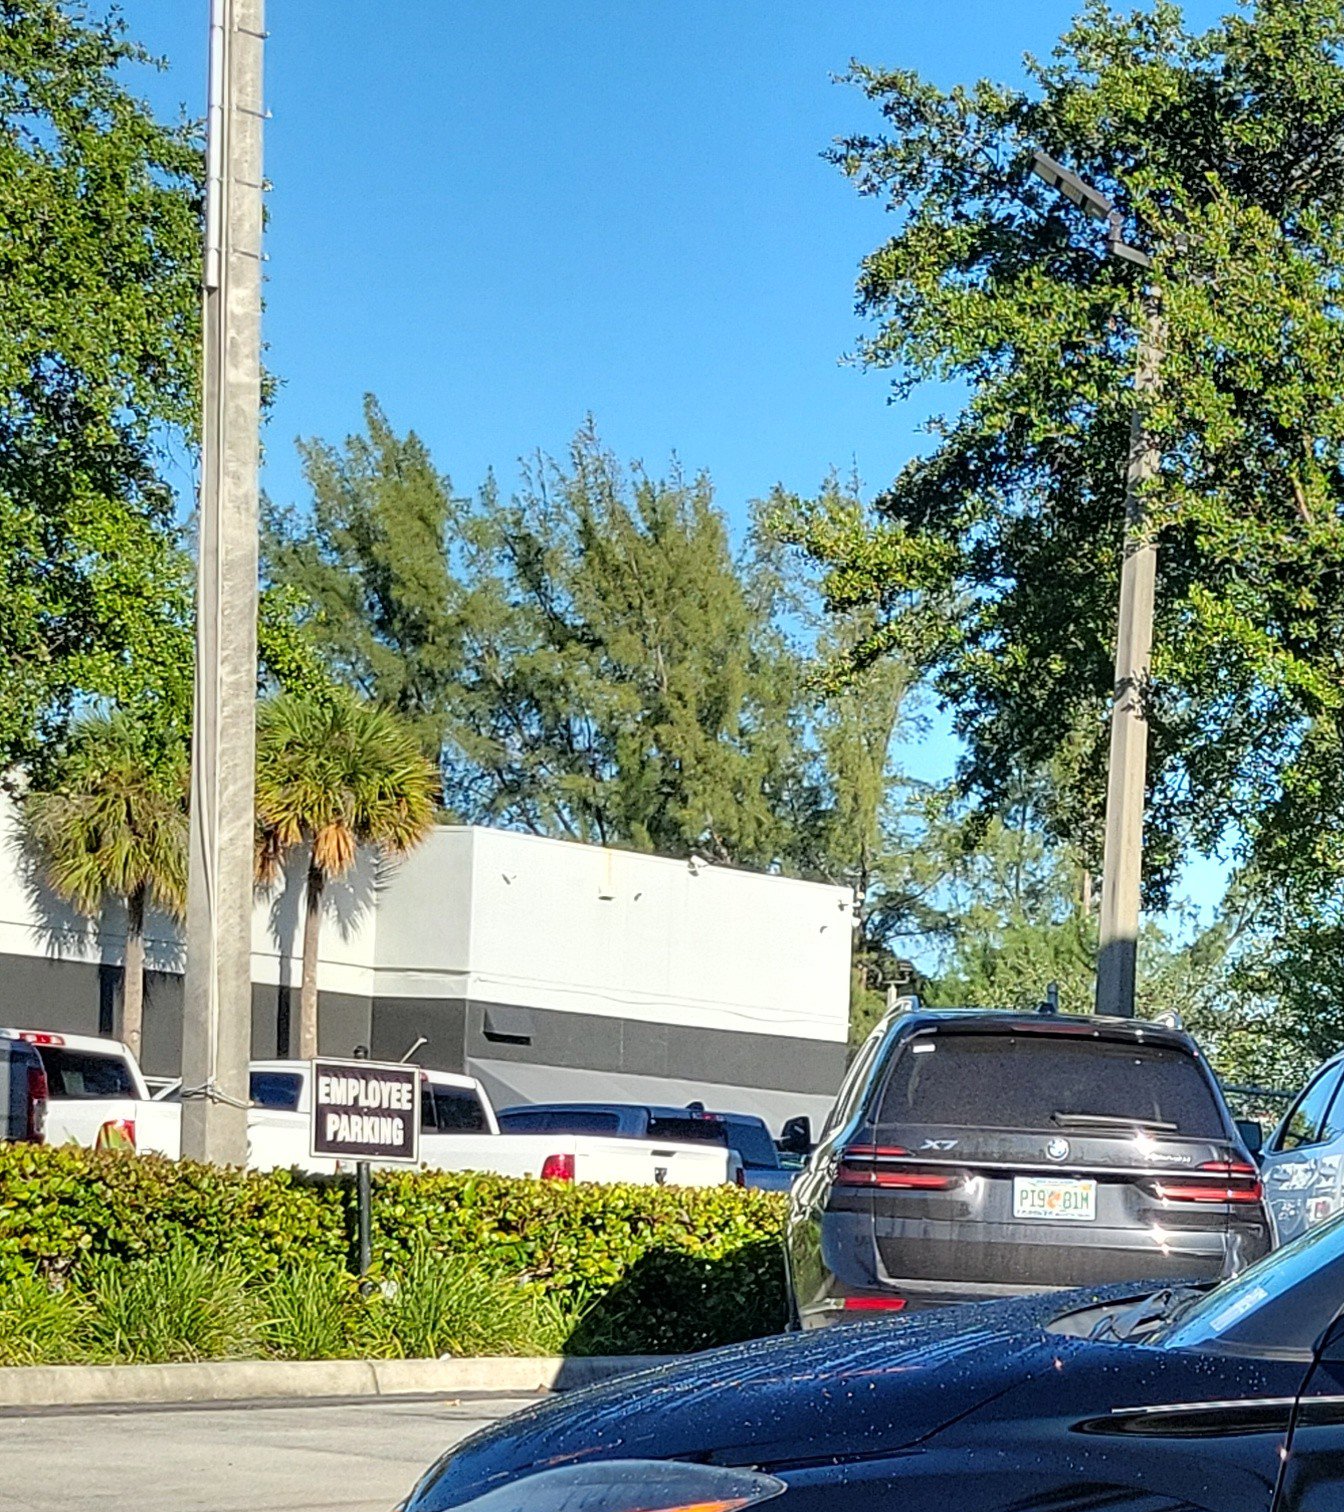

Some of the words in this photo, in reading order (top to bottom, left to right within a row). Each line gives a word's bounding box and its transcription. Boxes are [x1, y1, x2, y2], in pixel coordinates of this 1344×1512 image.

[318, 1075, 413, 1111] EMPLOYEE
[326, 1112, 405, 1147] PARKING
[919, 1138, 959, 1151] X7
